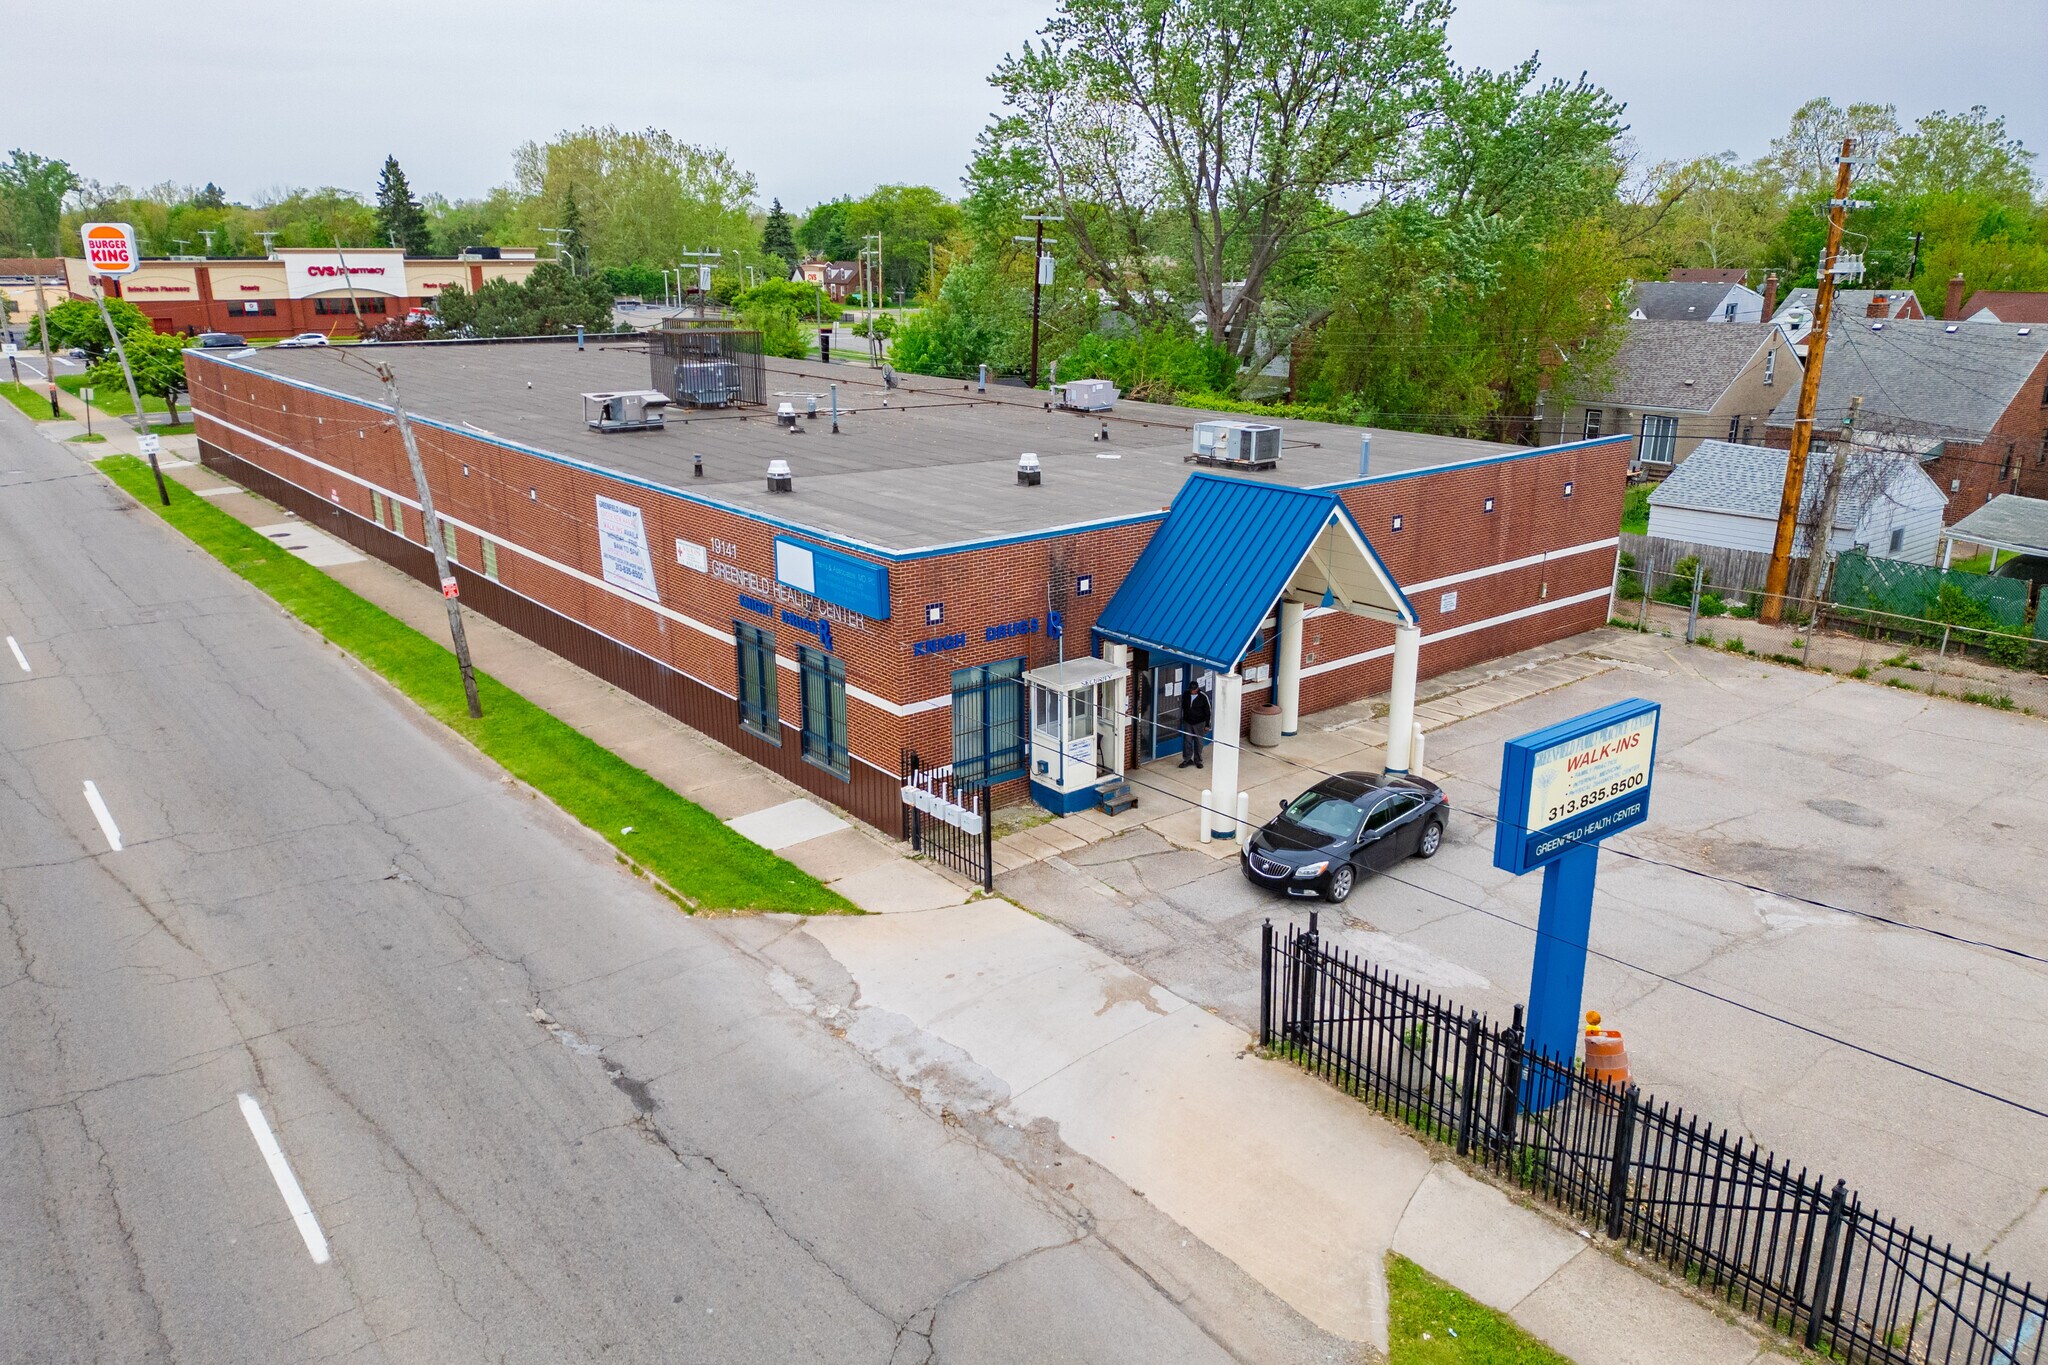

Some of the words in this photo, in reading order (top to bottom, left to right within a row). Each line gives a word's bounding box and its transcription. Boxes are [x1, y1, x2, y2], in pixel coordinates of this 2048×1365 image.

[88, 240, 127, 249] BURGER
[90, 249, 129, 262] KING
[807, 273, 818, 281] CVS
[711, 537, 737, 559] 19141
[713, 560, 770, 594] GREENFIELD
[773, 580, 815, 612] HEALTH
[818, 598, 865, 630] CENTER
[738, 592, 775, 618] KNIGHT
[781, 609, 818, 635] DRUGS
[914, 633, 966, 656] KNIGH
[986, 619, 1039, 641] DRUGS
[1567, 732, 1641, 772] WALK-INS
[1548, 772, 1643, 821] 313.835.8500
[1535, 828, 1583, 856] GREENFIELD
[1583, 817, 1612, 836] HEALTH
[1612, 803, 1641, 823] CENTER
